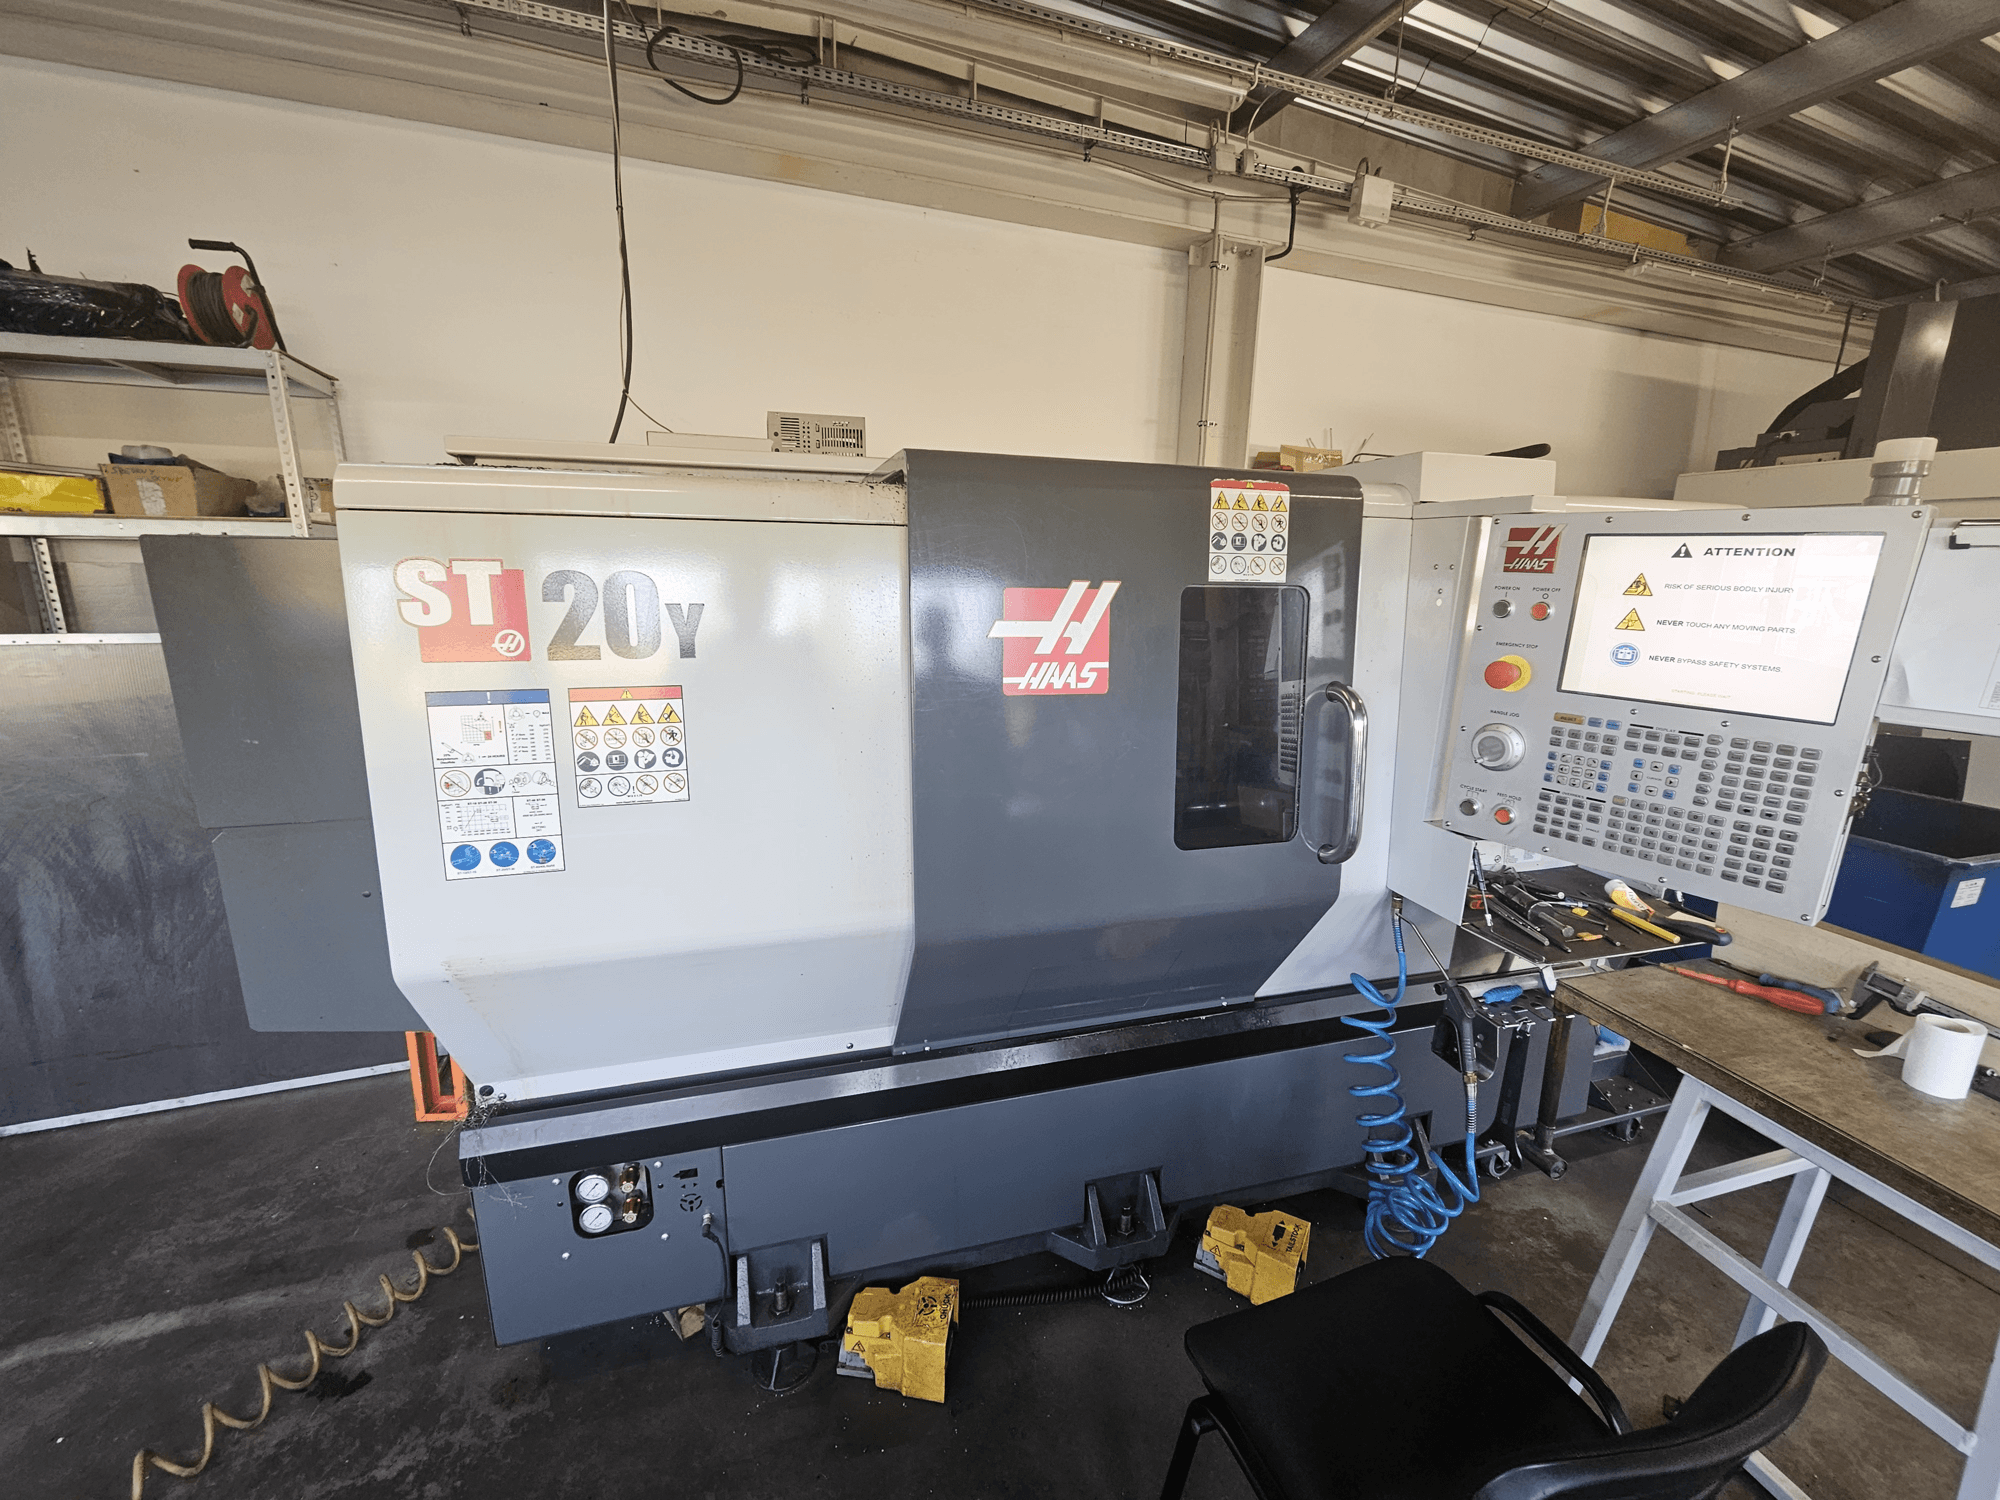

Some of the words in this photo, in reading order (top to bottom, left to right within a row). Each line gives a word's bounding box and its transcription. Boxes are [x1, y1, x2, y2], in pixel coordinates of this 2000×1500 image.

[1704, 548, 1796, 556] ATTENTION
[1504, 558, 1555, 570] HAAS
[394, 559, 503, 627] ST
[1696, 584, 1732, 592] SERIOUS
[1657, 619, 1684, 627] NEVER
[1686, 621, 1712, 629] TOUCH
[1732, 624, 1765, 632] MOVING
[1649, 655, 1676, 663] NEVER
[1677, 657, 1707, 666] BYPASS
[1709, 660, 1739, 669] SAFETY
[1741, 663, 1783, 673] SYSTEMS.
[1003, 662, 1109, 689] HAAS
[1286, 1223, 1302, 1252] TAILSTOCK
[939, 1293, 952, 1320] CHUCK
